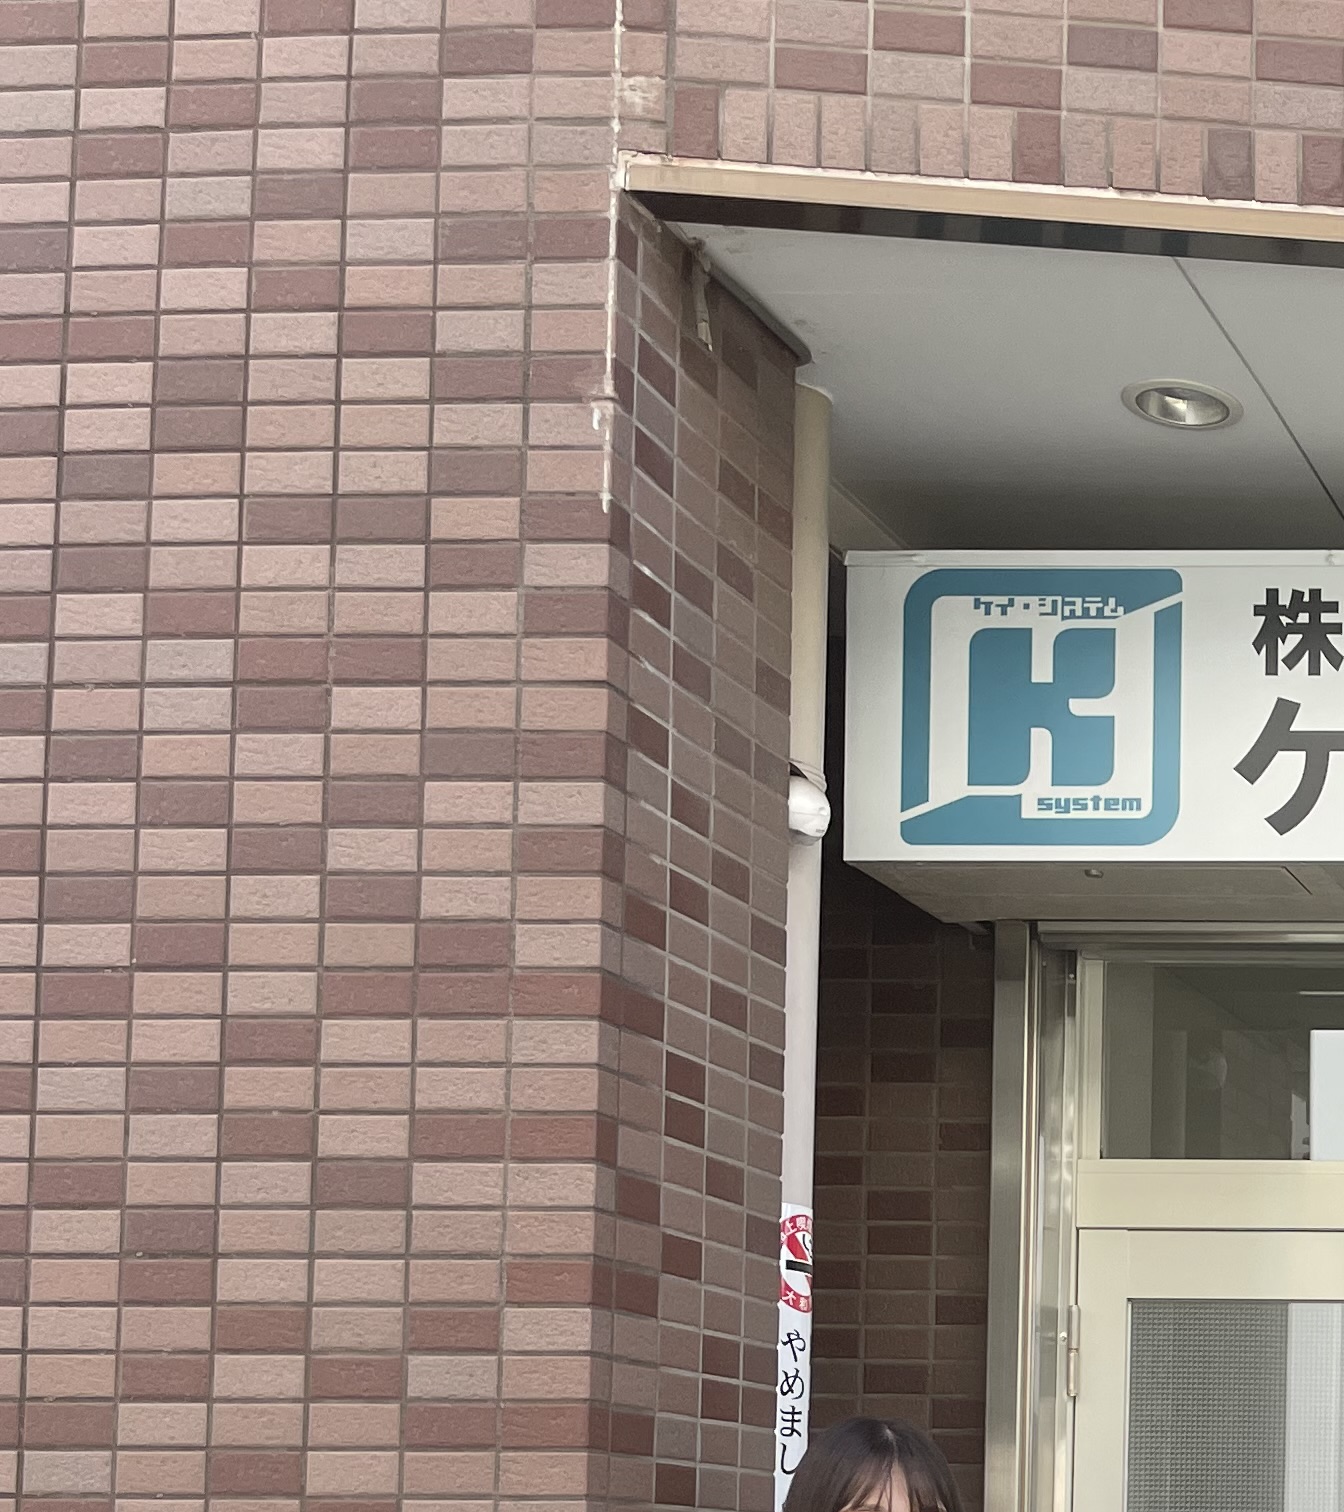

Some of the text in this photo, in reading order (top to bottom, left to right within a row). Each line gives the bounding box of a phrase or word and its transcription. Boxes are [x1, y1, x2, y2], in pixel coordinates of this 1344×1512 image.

[973, 597, 1125, 617] ケイ・システム
[1036, 795, 1142, 814] system
[779, 1329, 806, 1475] やめまし
